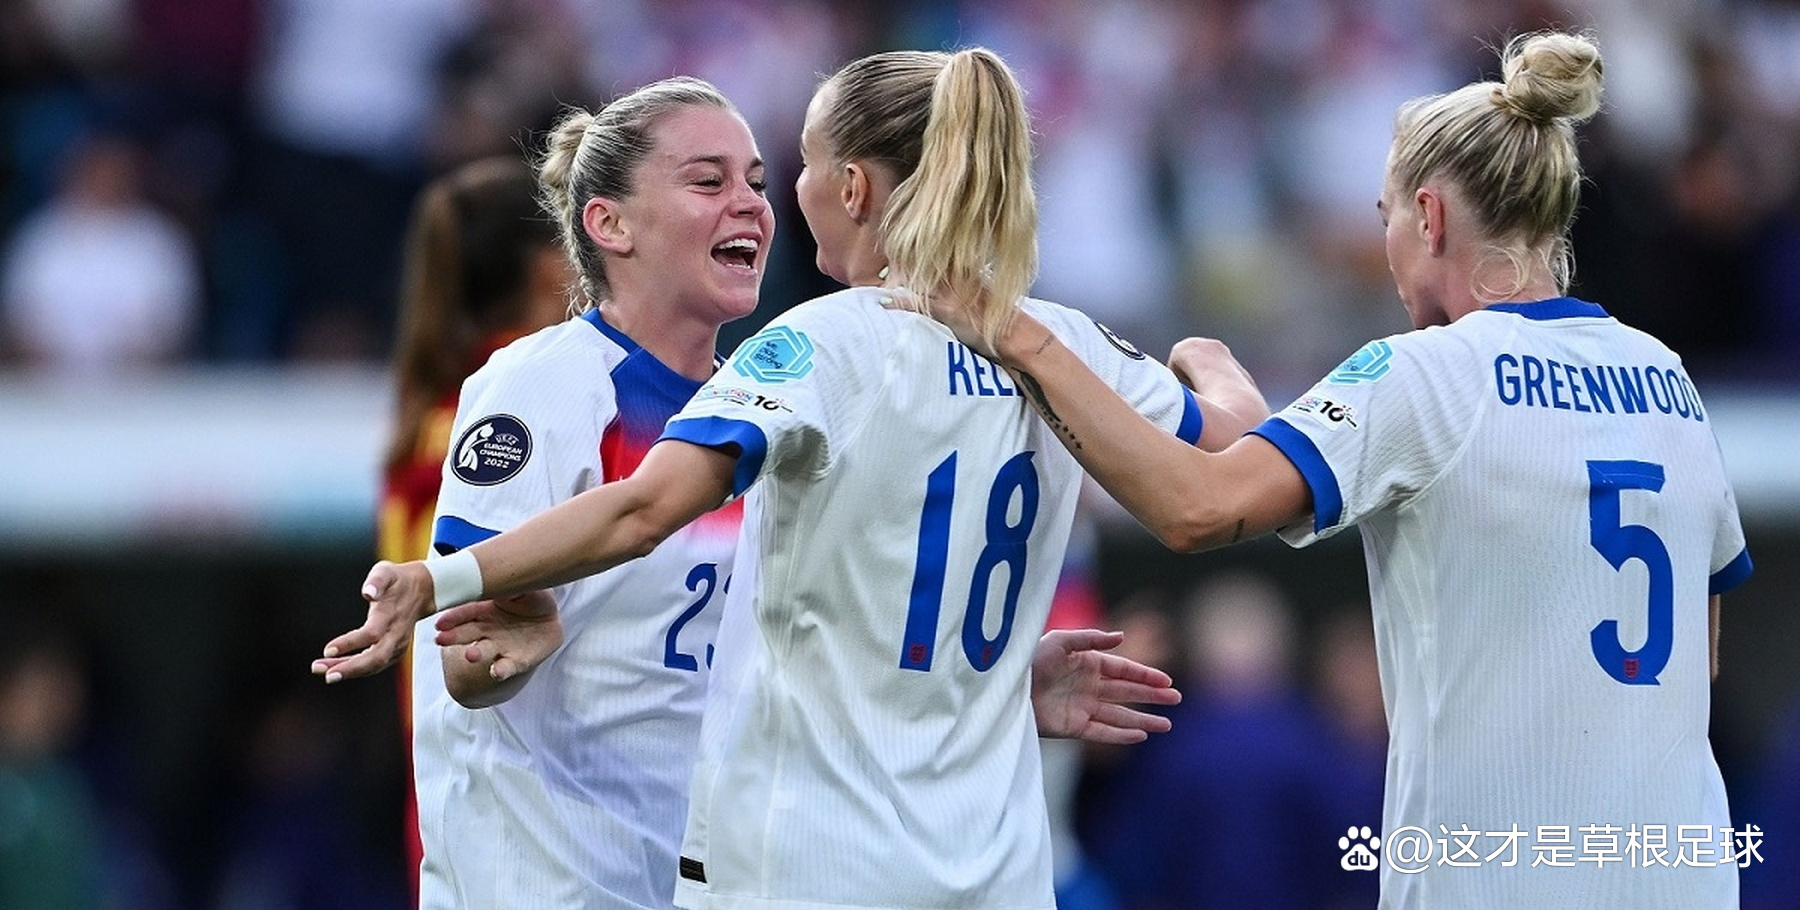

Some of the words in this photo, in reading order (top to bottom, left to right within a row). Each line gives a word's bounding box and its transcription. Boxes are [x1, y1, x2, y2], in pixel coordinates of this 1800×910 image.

[948, 341, 1023, 396] KEL
[1494, 353, 1704, 422] GREENWOOD
[480, 449, 522, 462] CHAMPIONS
[484, 442, 523, 455] EUROPEAN
[484, 458, 510, 469] 2022
[899, 449, 1040, 673] 18
[1586, 459, 1673, 686] 5
[664, 562, 732, 673] 2
